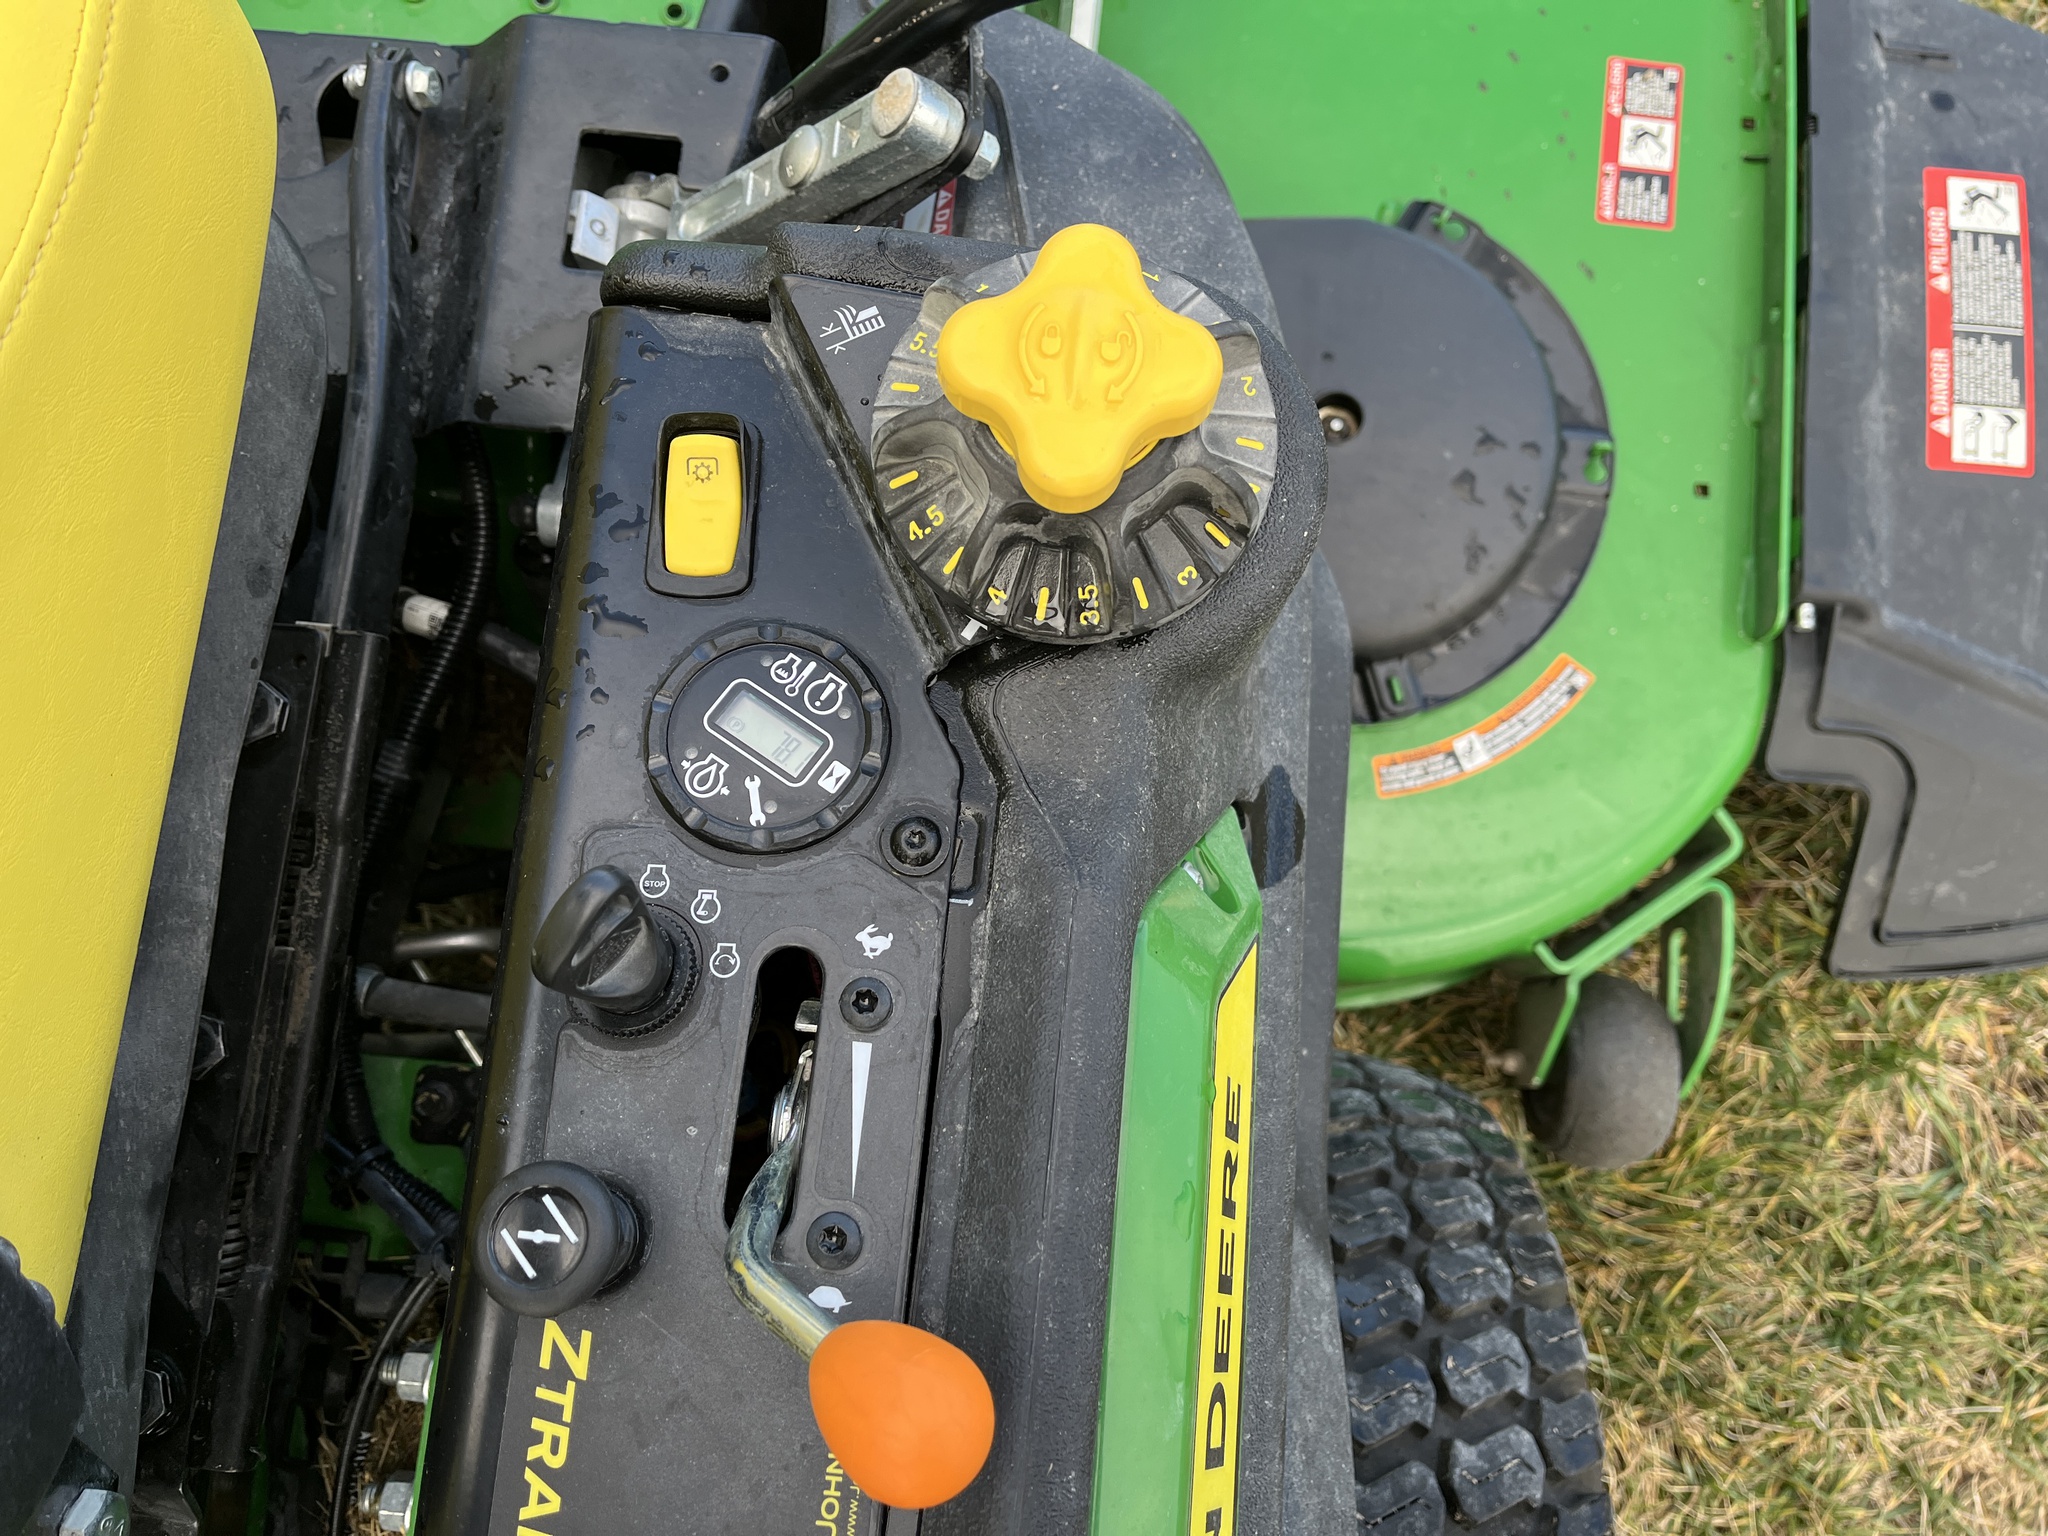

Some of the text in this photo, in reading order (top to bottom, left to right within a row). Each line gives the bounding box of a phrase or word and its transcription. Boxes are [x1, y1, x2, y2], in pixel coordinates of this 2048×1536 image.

[1240, 376, 1257, 396] 2
[907, 504, 945, 541] 4.5
[1176, 565, 1199, 587] 3
[987, 584, 1007, 604] 4
[1078, 584, 1100, 625] 3.5
[644, 880, 666, 888] STOP
[1205, 1075, 1242, 1470] DEERE
[516, 1318, 593, 1536] ZTRA
